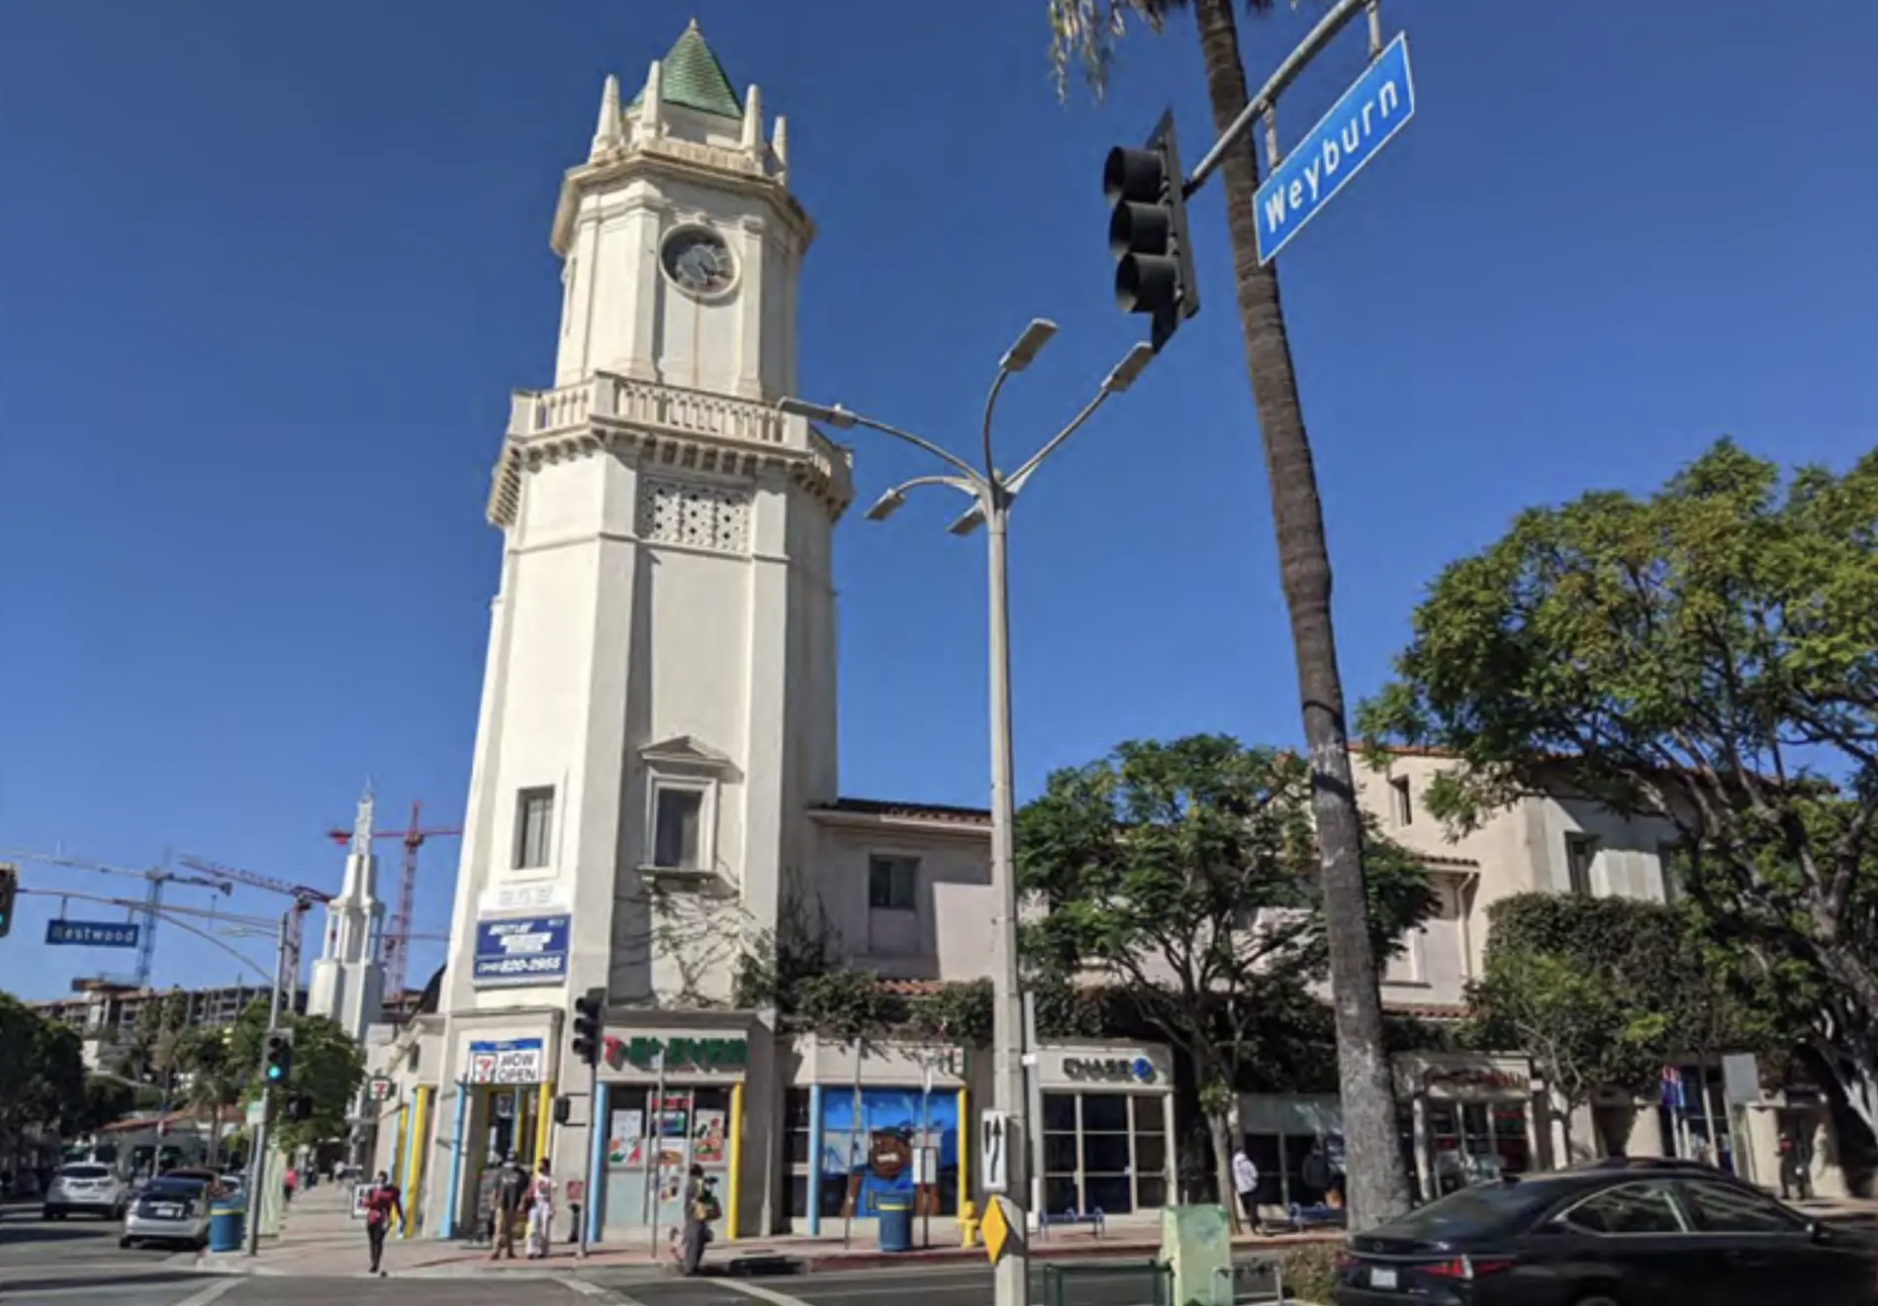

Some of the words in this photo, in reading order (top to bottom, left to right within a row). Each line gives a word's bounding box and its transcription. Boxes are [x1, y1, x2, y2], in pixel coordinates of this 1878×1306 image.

[1265, 81, 1398, 234] Weyburn
[500, 1052, 536, 1067] NOW
[1063, 1058, 1130, 1077] CHASE
[498, 1068, 537, 1083] OPEN
